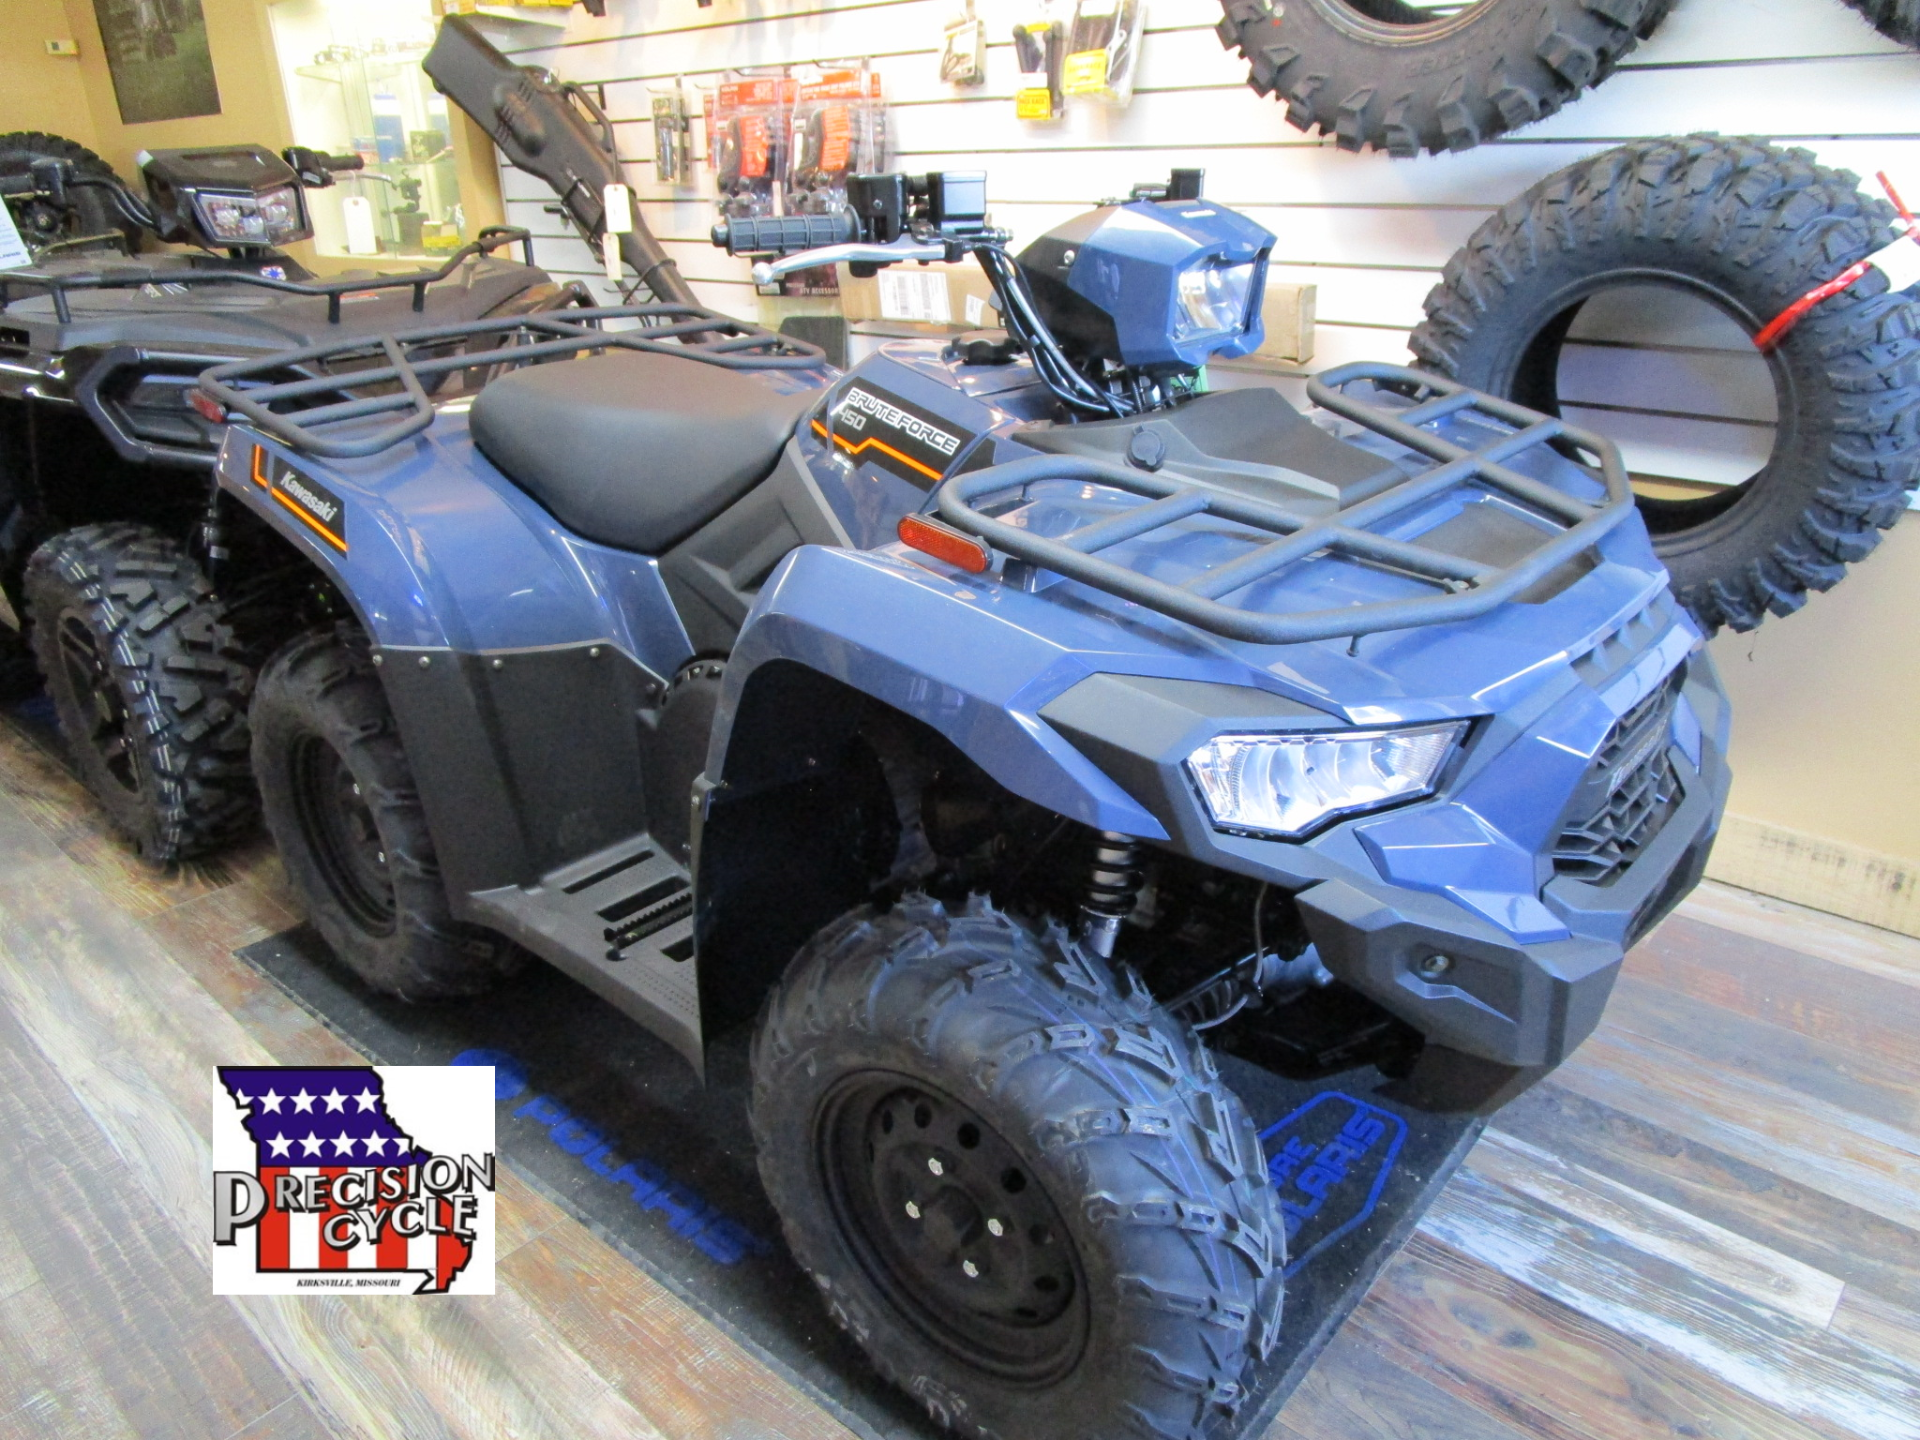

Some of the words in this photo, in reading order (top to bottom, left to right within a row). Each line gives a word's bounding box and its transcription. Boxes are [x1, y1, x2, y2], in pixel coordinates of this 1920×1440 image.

[837, 407, 867, 432] 450
[846, 386, 899, 429] BRUTE
[897, 409, 961, 456] FORCE
[280, 470, 338, 522] Kawasaki
